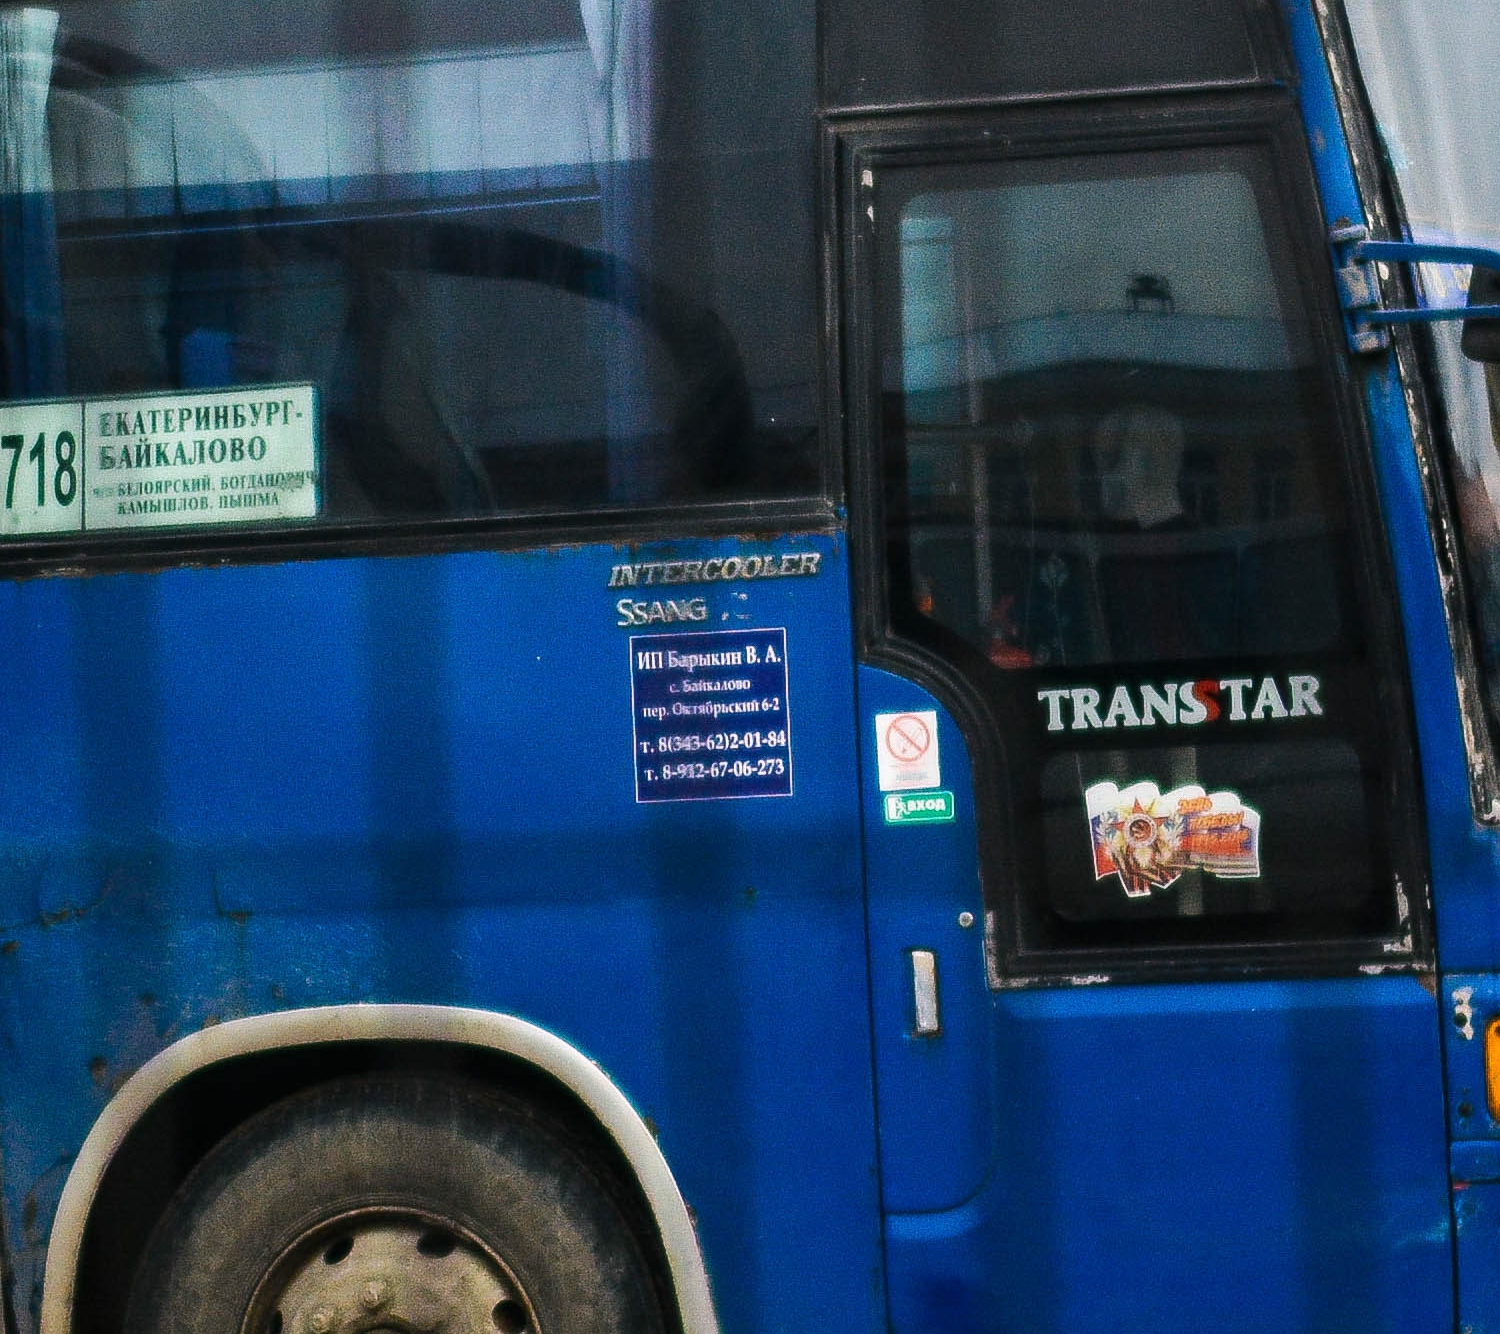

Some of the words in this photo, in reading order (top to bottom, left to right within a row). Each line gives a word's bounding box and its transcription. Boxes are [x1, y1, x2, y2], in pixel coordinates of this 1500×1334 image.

[100, 400, 303, 437] ЕКАТЕРИНБУРГ-
[99, 435, 267, 470] БАЙКАЛОВО
[0, 430, 77, 509] 718
[218, 491, 280, 510] ПЫШМА
[608, 551, 822, 587] INTERCOOLER
[637, 651, 664, 670] ИП
[668, 650, 742, 673] Барыкин
[746, 645, 761, 665] В.
[765, 644, 782, 664] А.
[682, 678, 751, 693] Байкалово
[642, 706, 669, 720] пер.
[672, 698, 760, 718] Октябрьский
[761, 697, 780, 712] 6-2
[640, 741, 655, 754] т.
[658, 729, 787, 753] 8(343-62)2-01-84
[644, 769, 659, 782] т.
[662, 758, 785, 780] 8-912-67-06-273
